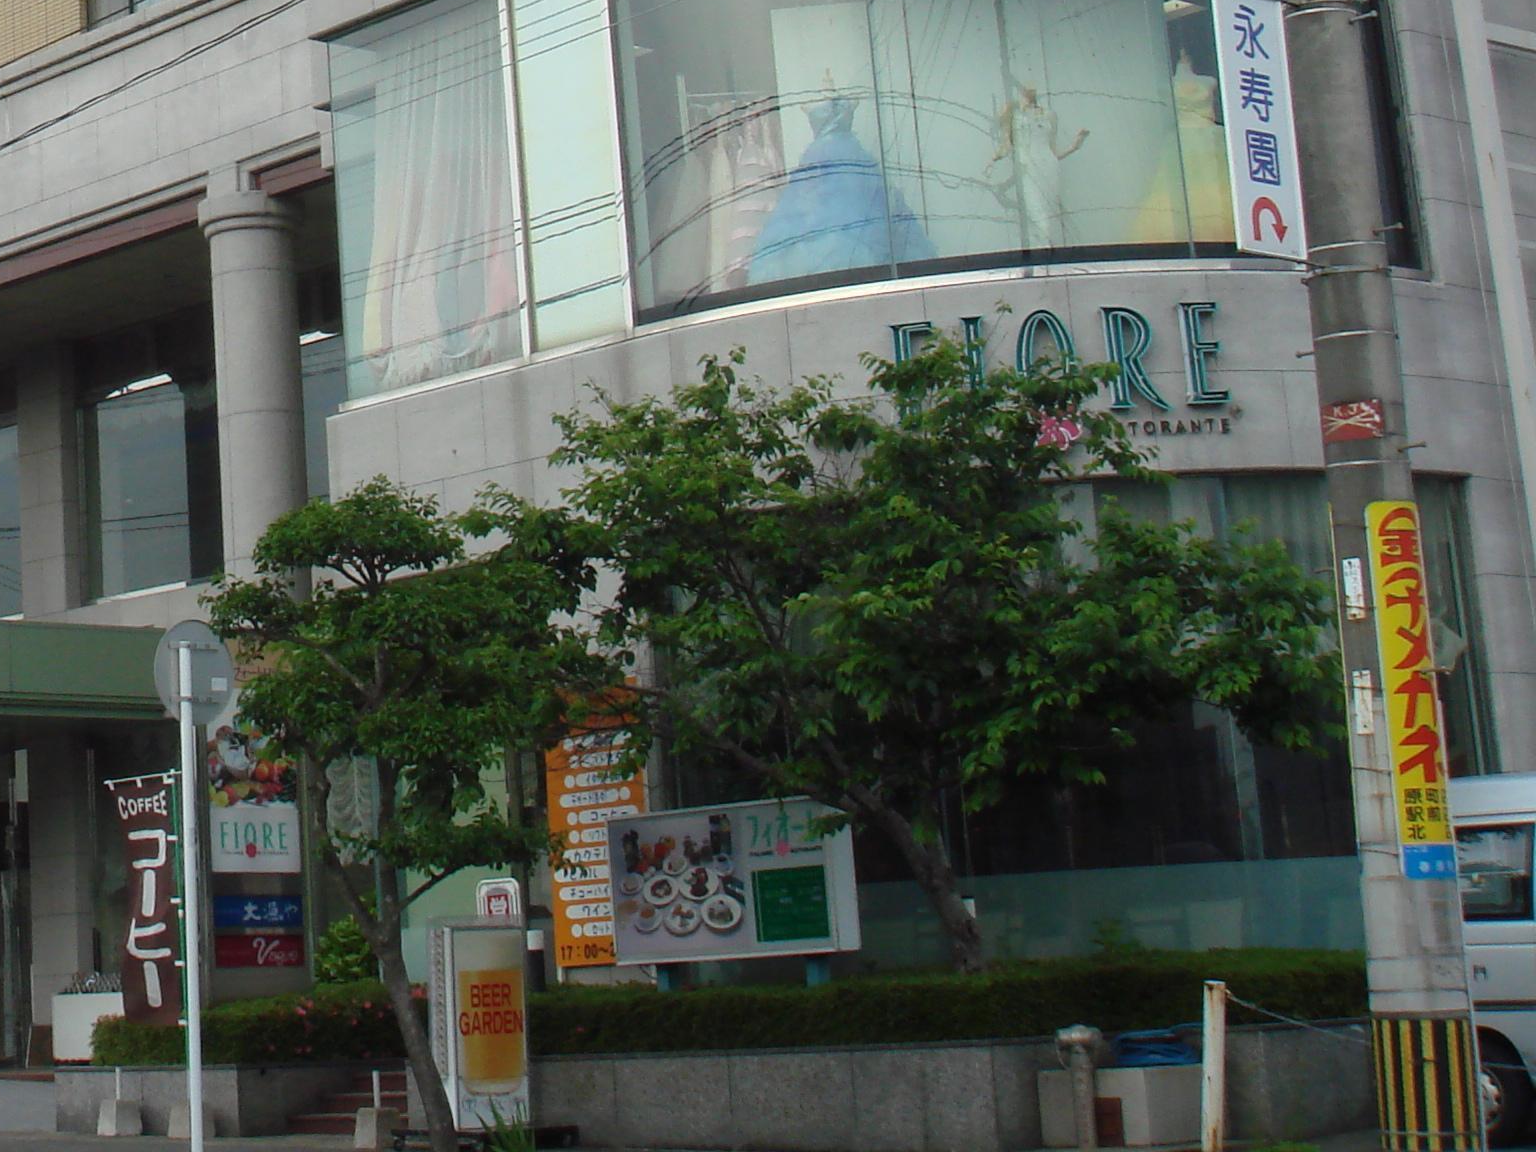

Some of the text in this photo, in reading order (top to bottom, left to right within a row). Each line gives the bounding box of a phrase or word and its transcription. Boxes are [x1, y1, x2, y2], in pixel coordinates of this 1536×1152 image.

[1233, 4, 1282, 186] 永寿園
[118, 790, 167, 820] COFFEE
[220, 822, 288, 850] FIORE
[127, 829, 172, 1007] コーヒー
[470, 984, 512, 1008] BEER
[459, 1012, 524, 1037] GARDEN
